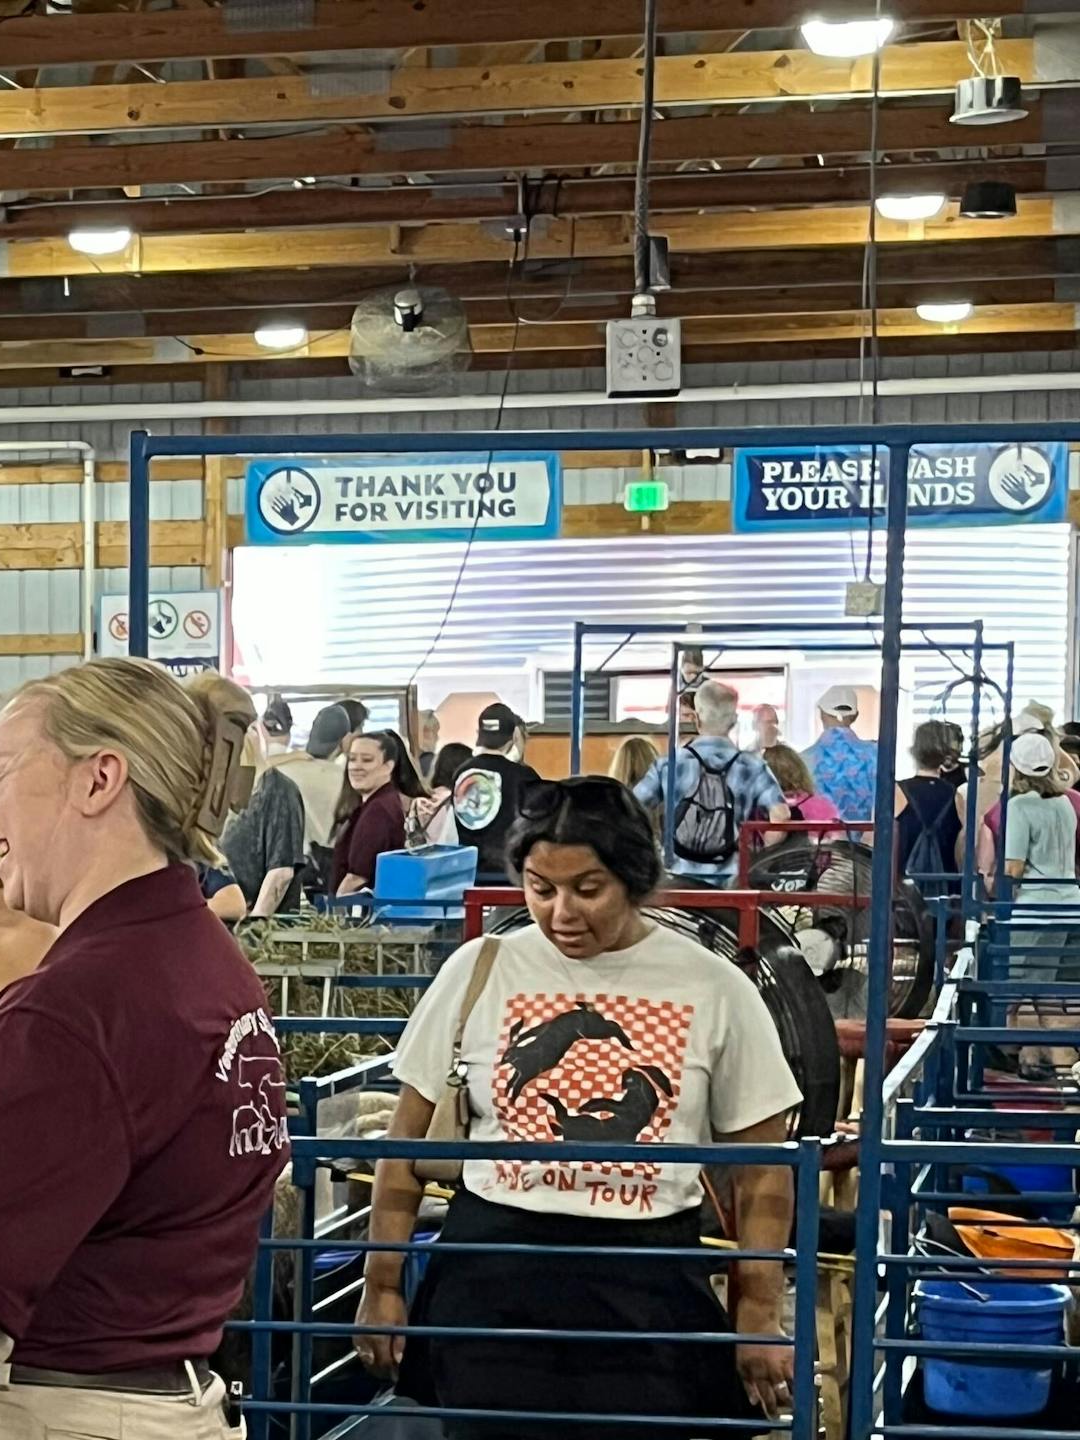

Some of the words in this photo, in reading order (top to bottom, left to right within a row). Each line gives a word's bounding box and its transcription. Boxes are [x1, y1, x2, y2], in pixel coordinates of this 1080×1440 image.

[762, 459, 880, 483] PLEASE
[335, 473, 445, 498] THANK
[452, 472, 516, 494] YOU
[762, 485, 850, 511] YOUR
[860, 483, 975, 509] HNDS
[335, 502, 388, 522] FOR
[395, 498, 516, 521] VISITING
[542, 1169, 576, 1191] ON
[585, 1180, 658, 1213] TOUR
